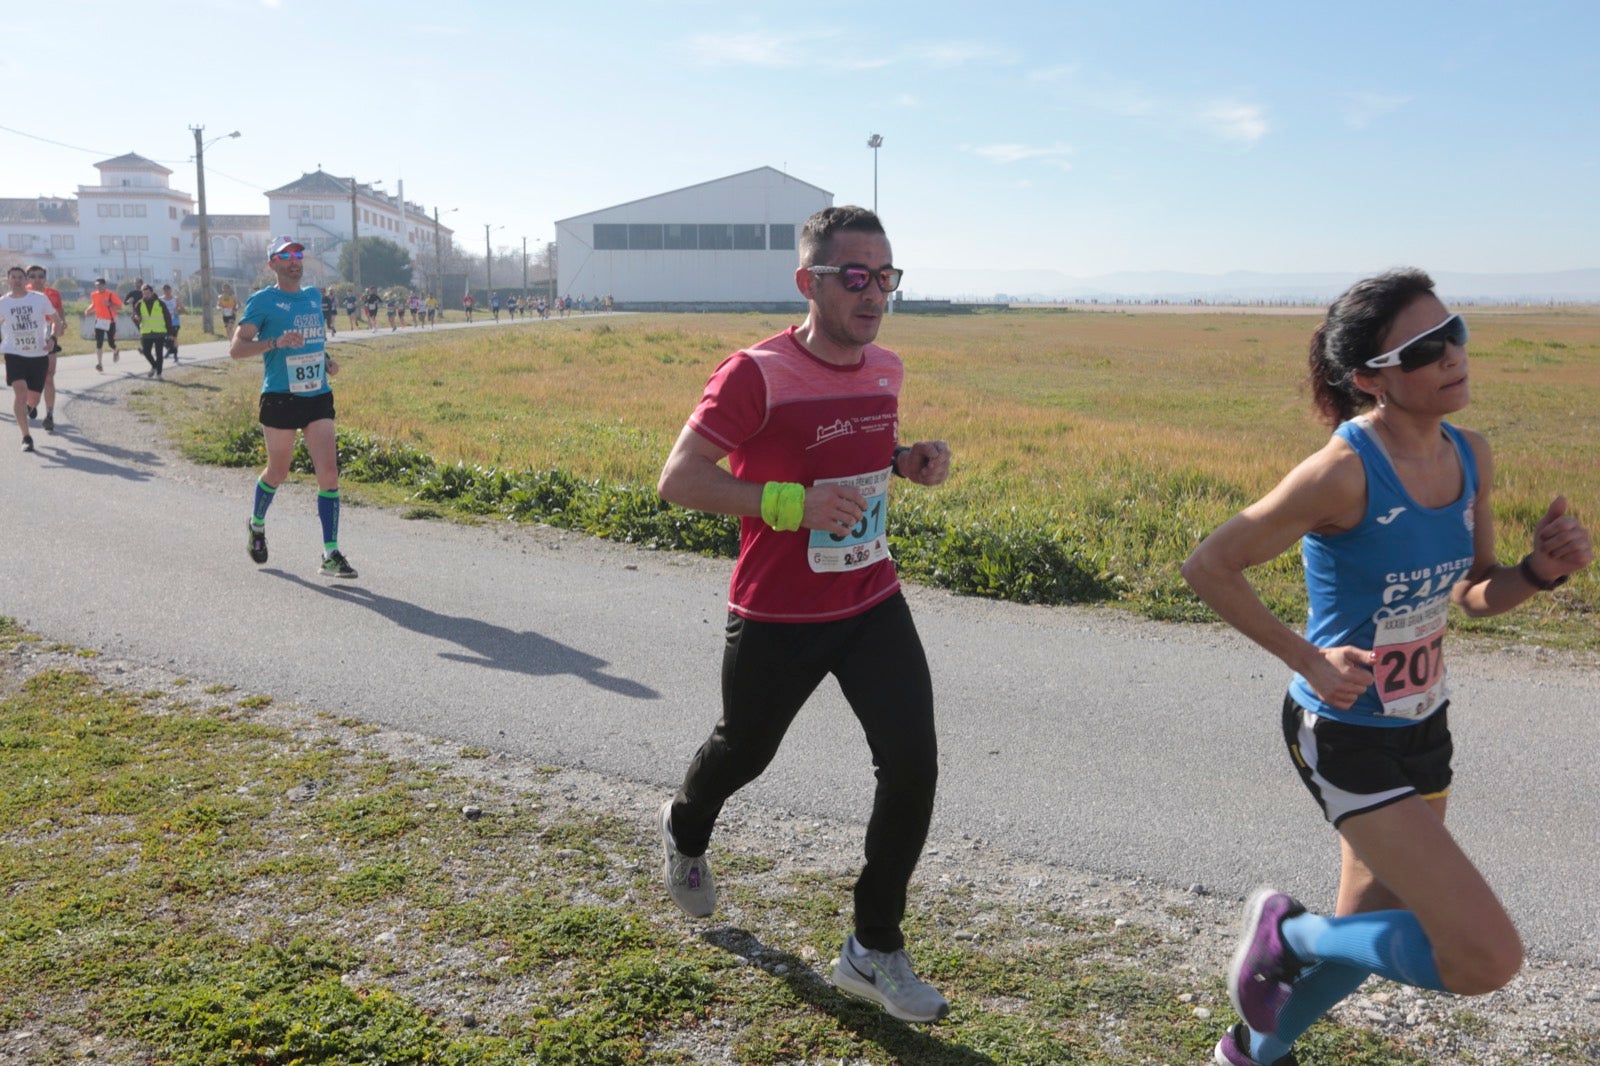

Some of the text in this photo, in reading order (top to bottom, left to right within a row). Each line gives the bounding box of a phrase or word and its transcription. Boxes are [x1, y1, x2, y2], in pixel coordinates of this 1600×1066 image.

[10, 306, 33, 316] PUSH
[16, 314, 31, 322] THE
[294, 313, 319, 328] 42K
[11, 320, 38, 331] LIMITS
[15, 337, 36, 345] 3102
[296, 363, 320, 381] 837
[1385, 567, 1431, 584] CLUB
[1381, 639, 1441, 693] 207
